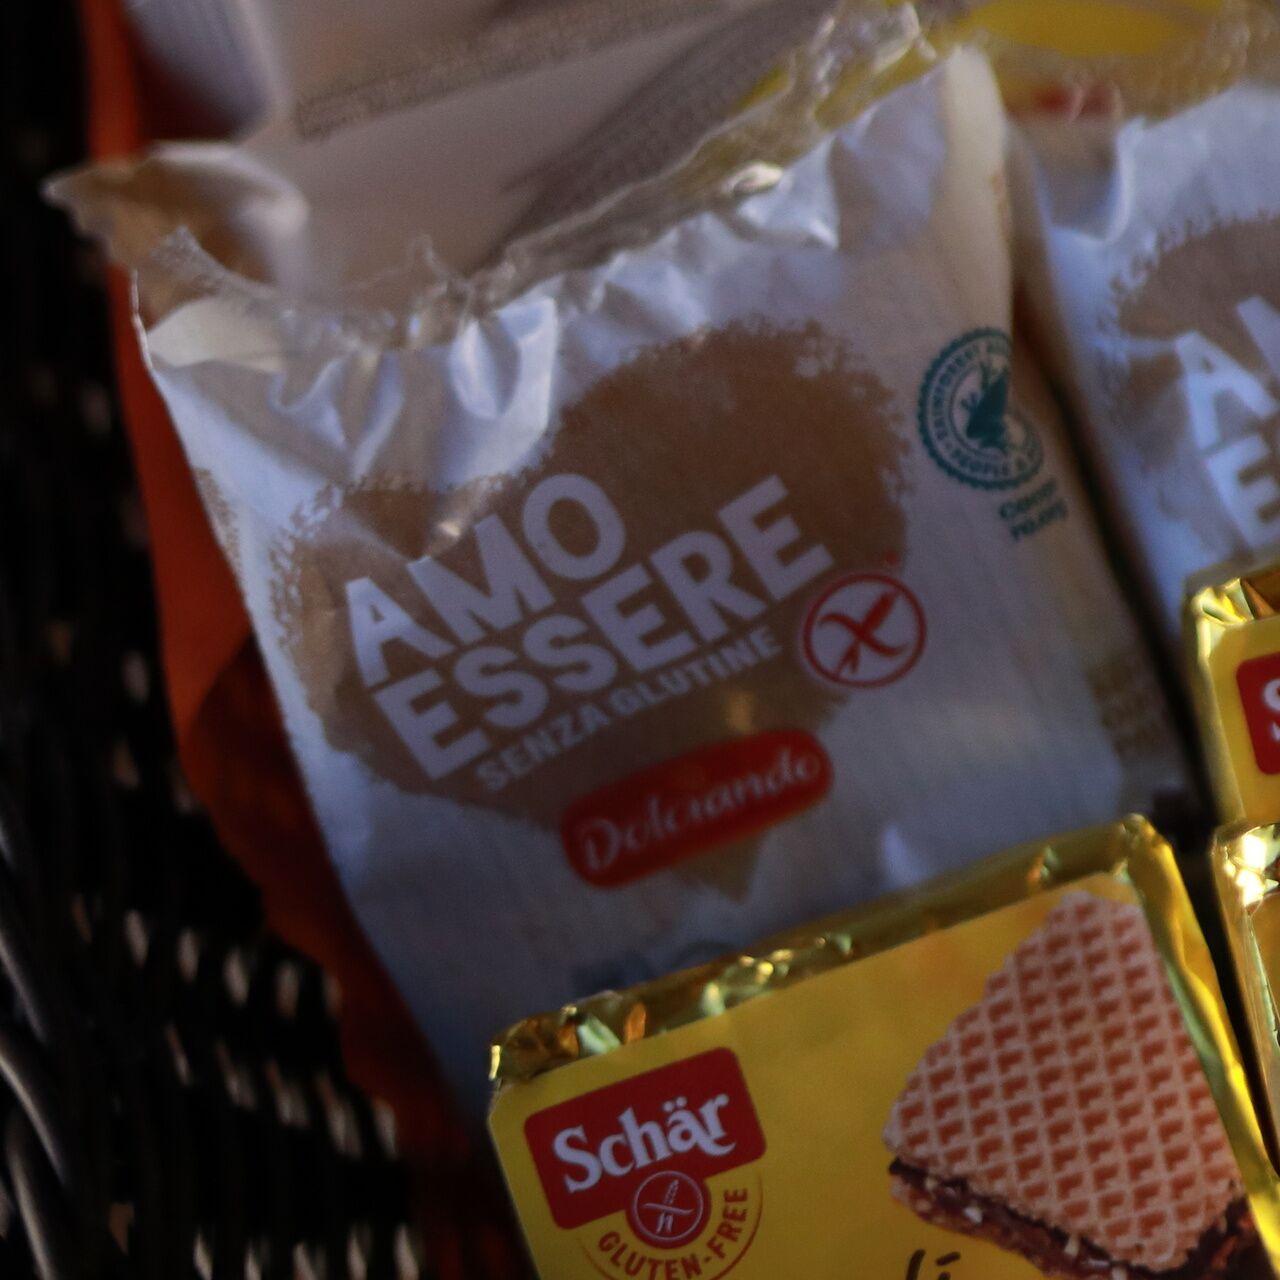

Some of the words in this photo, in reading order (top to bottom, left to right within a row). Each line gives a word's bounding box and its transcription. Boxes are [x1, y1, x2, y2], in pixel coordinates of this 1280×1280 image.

[344, 472, 626, 687] AMO
[371, 474, 835, 782] ESSERE
[473, 696, 612, 792] SENZA
[609, 624, 783, 720] GLUTINE
[580, 744, 823, 872] Dolciando
[552, 1092, 738, 1194] Schär
[598, 1187, 749, 1280] GLUTEN-FREE
